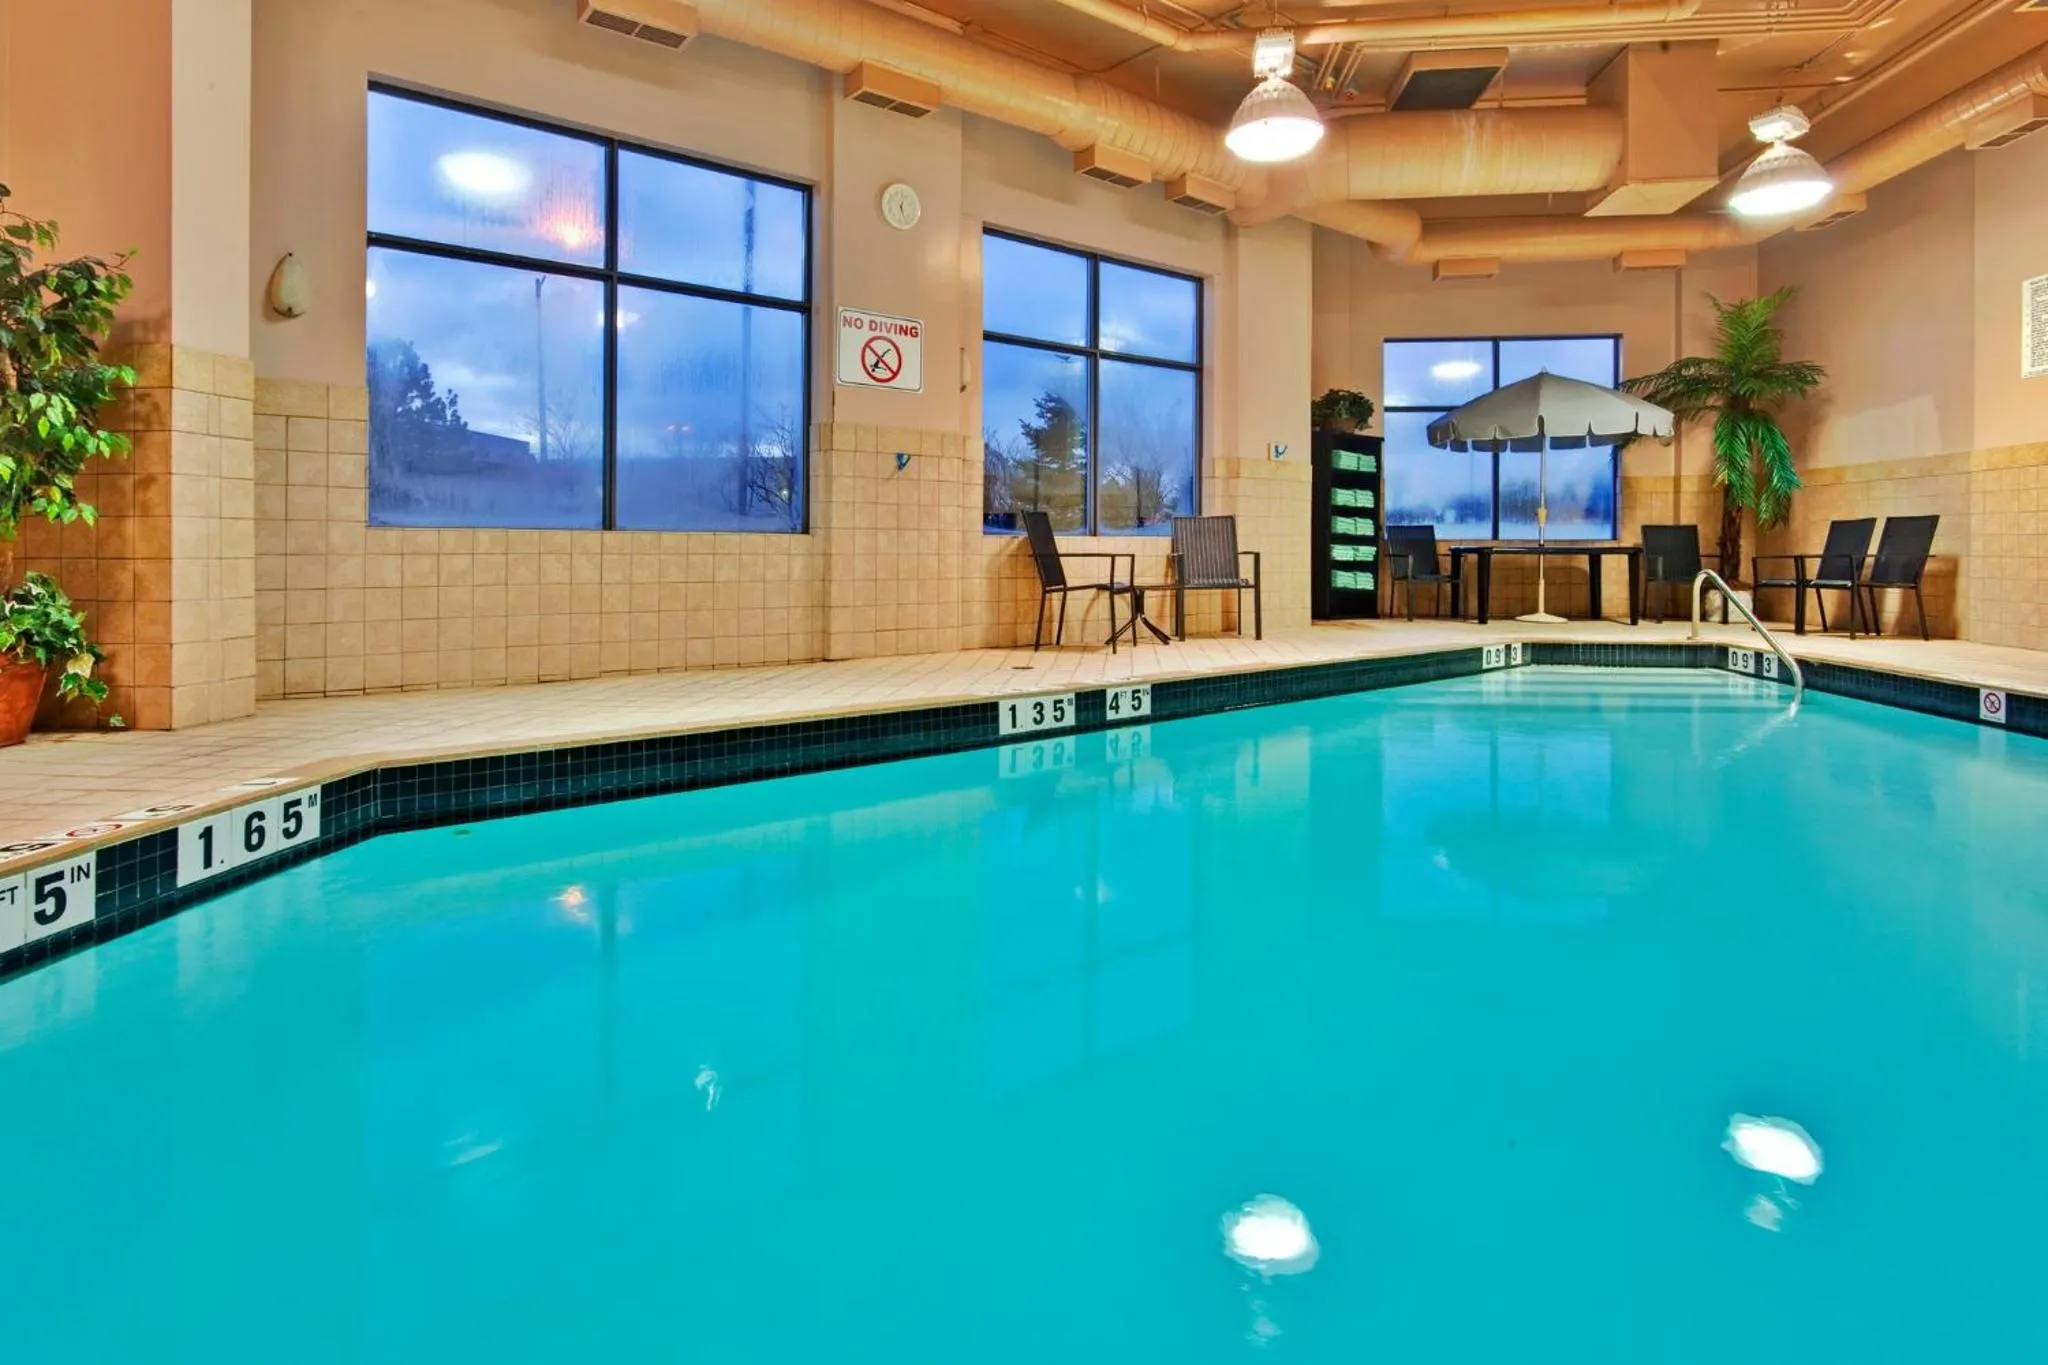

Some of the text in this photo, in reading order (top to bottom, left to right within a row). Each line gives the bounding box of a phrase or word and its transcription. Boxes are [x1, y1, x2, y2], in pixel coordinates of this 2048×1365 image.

[843, 316, 919, 338] NO DIVING
[34, 870, 67, 926] 5
[70, 862, 91, 884] IN
